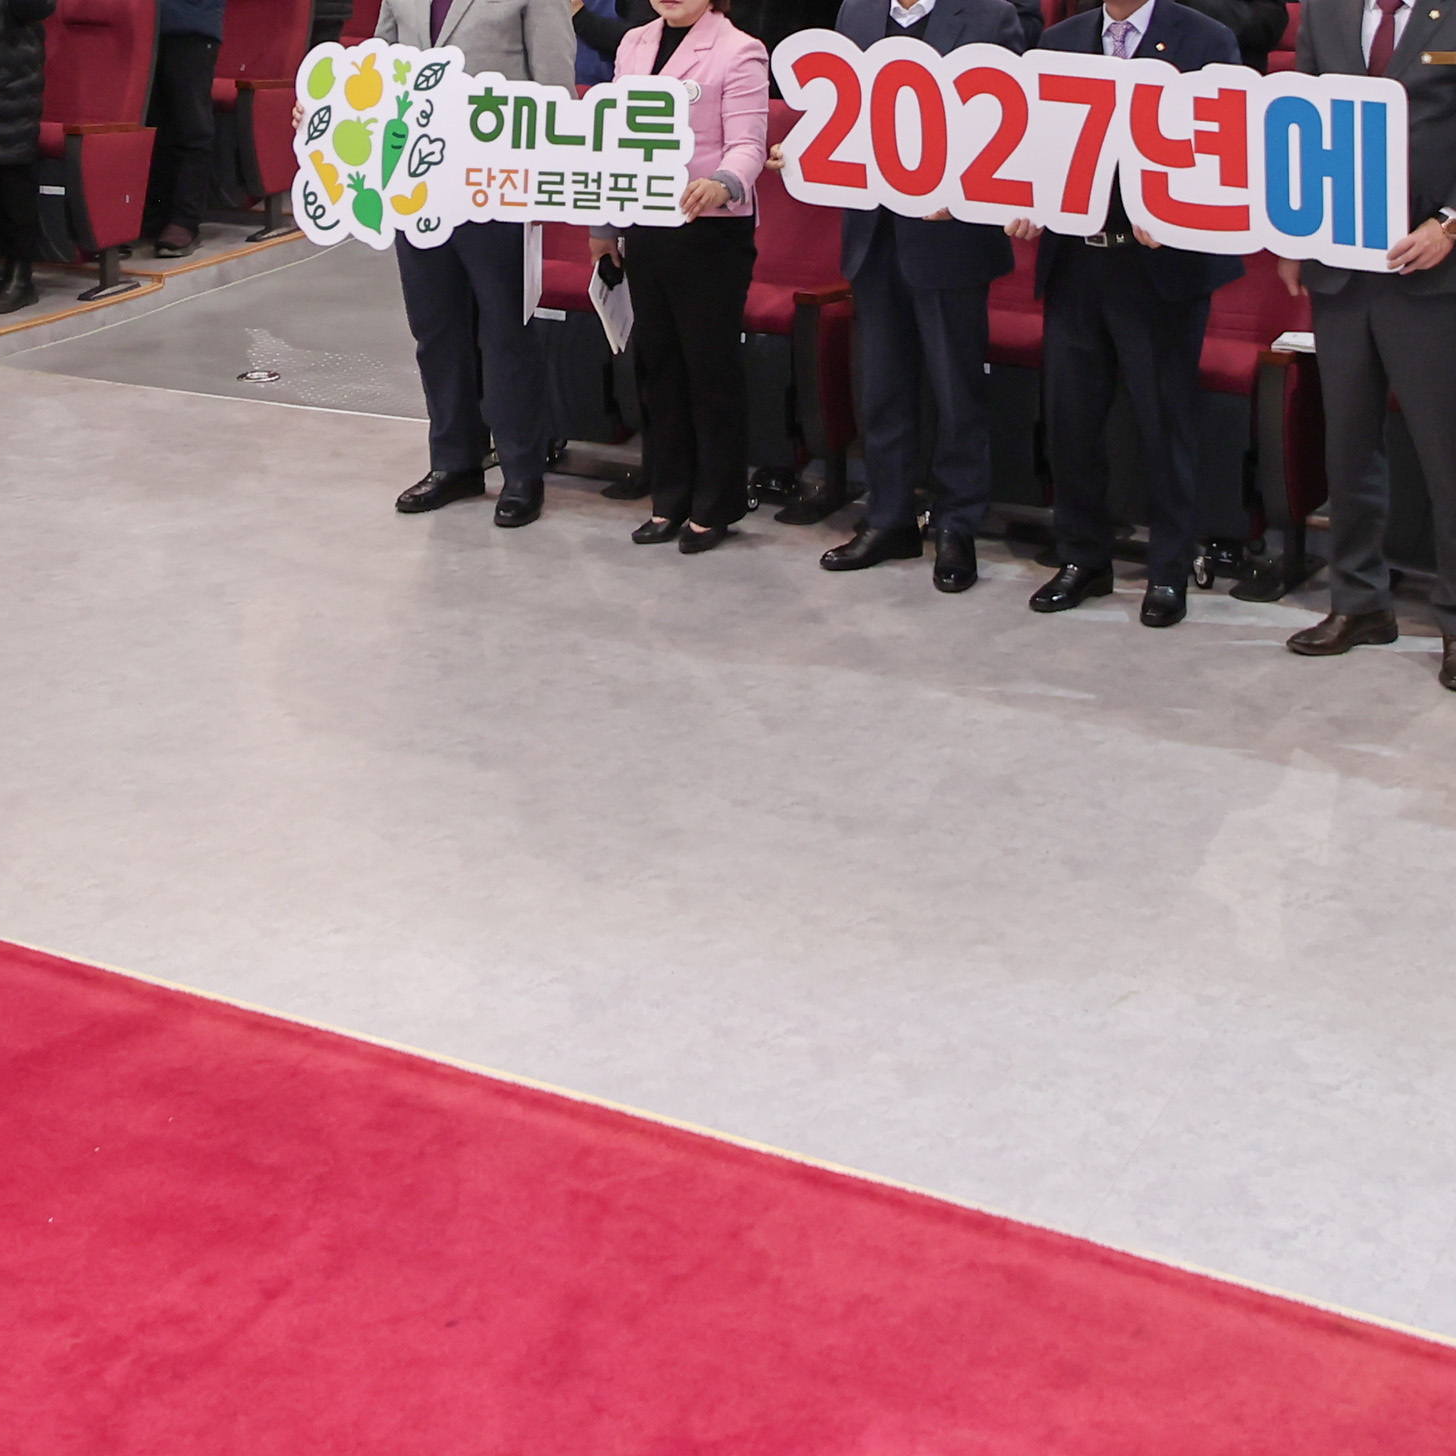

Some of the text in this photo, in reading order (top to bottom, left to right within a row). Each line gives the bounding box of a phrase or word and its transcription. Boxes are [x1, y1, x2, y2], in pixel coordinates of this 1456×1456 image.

[467, 86, 681, 163] 해나루
[791, 52, 1389, 251] 2027년에
[464, 166, 677, 213] 당진로컬푸드
